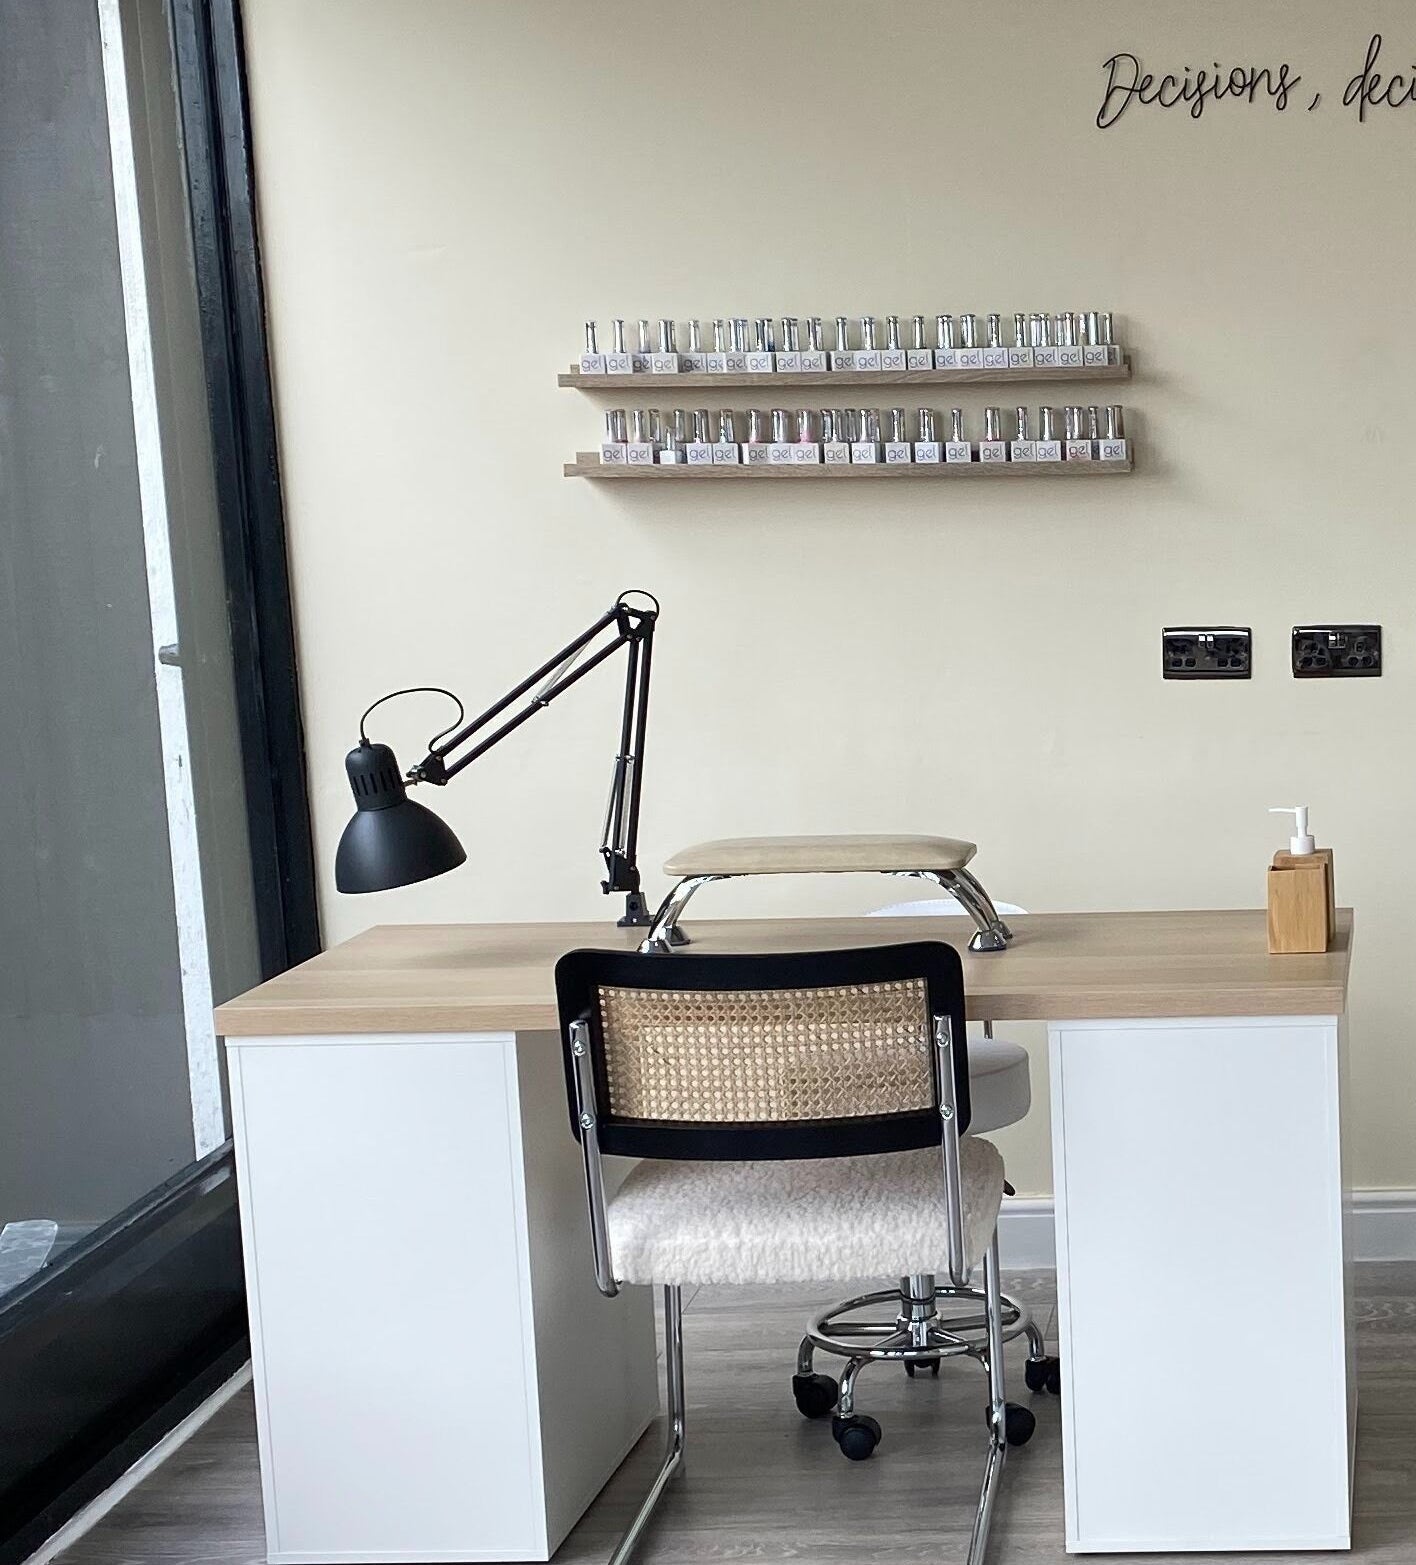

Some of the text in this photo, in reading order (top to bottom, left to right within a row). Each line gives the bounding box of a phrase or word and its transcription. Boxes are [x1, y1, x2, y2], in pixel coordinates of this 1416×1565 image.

[608, 354, 630, 371] gel
[653, 354, 674, 371] gel
[726, 354, 746, 371] gel
[750, 353, 769, 371] gel
[778, 352, 798, 370] gel
[802, 352, 822, 370] gel
[835, 352, 854, 369] gel
[858, 352, 878, 369] gel
[883, 351, 903, 369] gel
[909, 352, 928, 369] gel
[937, 351, 957, 367] gel
[960, 352, 982, 366] gel
[985, 352, 1005, 367] gel
[1011, 351, 1031, 365] gel
[1035, 350, 1056, 365] gel
[1060, 350, 1081, 365] gel
[1085, 349, 1106, 363] gel
[581, 356, 602, 372] gel
[603, 448, 625, 462] gel
[629, 448, 650, 462] gel
[689, 447, 710, 462] gel
[715, 447, 736, 462] gel
[749, 449, 769, 462] gel
[771, 448, 792, 462] gel
[796, 447, 816, 462] gel
[826, 447, 847, 462] gel
[852, 446, 872, 461] gel
[887, 446, 909, 461] gel
[916, 446, 937, 461] gel
[949, 443, 968, 459] gel
[982, 445, 1003, 460] gel
[1013, 443, 1034, 459] gel
[1037, 443, 1058, 459] gel
[1069, 443, 1089, 459] gel
[1103, 441, 1123, 458] gel
